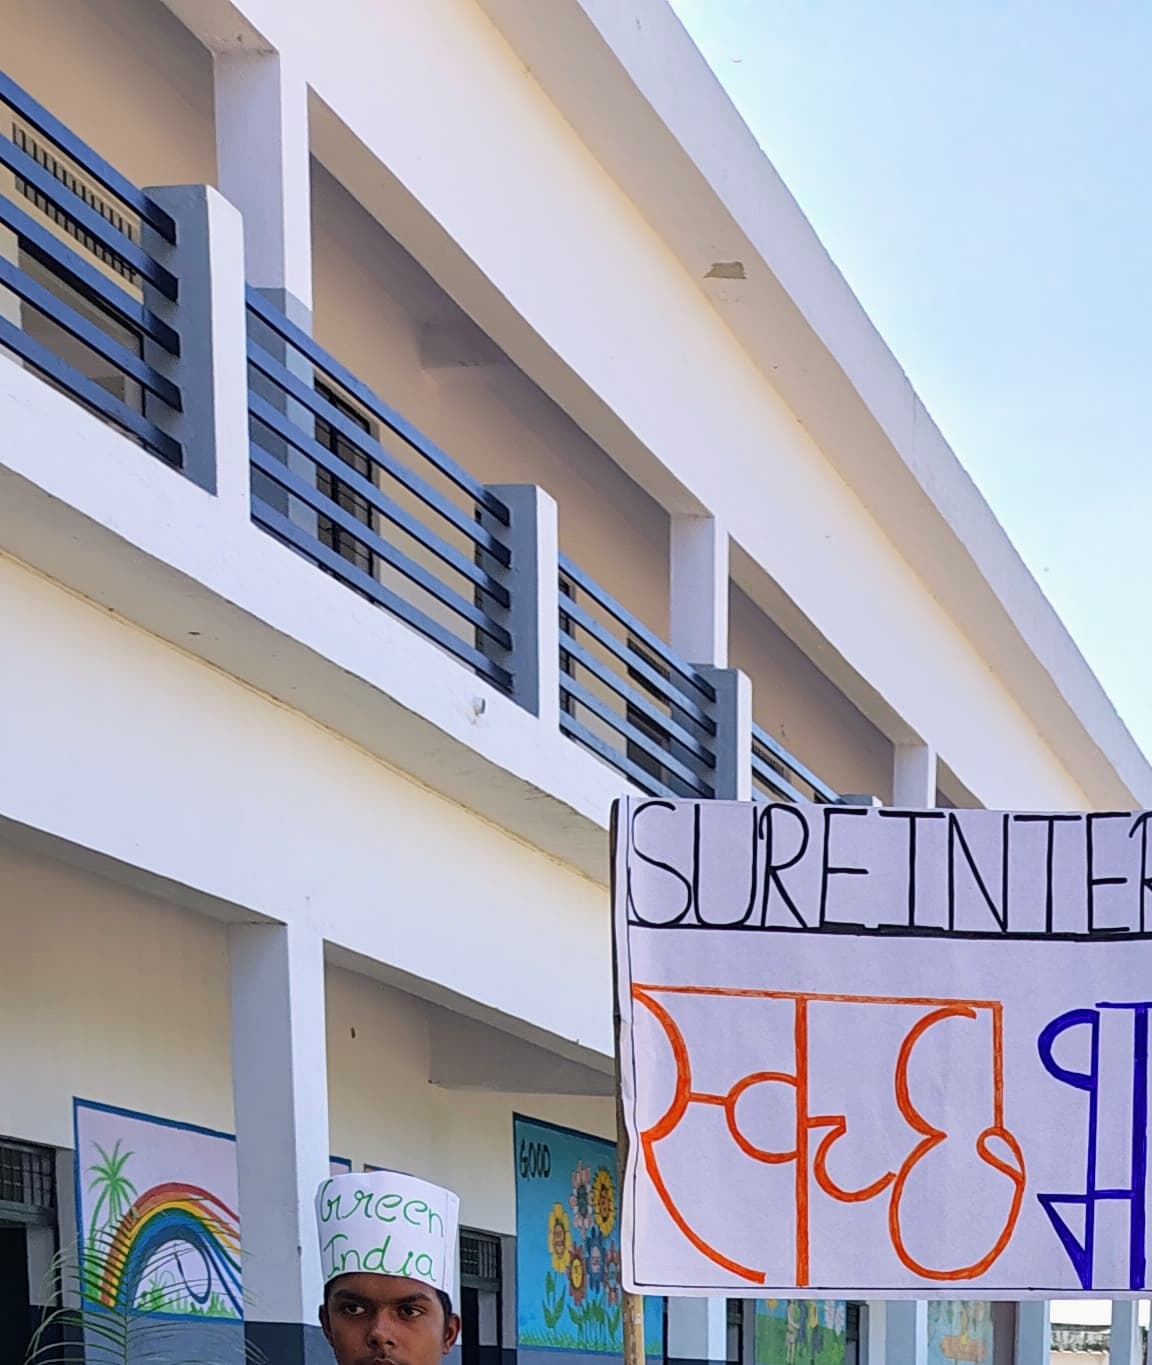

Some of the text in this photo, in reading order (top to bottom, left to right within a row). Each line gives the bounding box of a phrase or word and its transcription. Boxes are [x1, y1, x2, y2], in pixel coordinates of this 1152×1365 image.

[628, 800, 869, 930] SURE
[632, 983, 1026, 1287] स्वच्छ
[320, 1178, 445, 1238] Green
[323, 1233, 437, 1282] India
